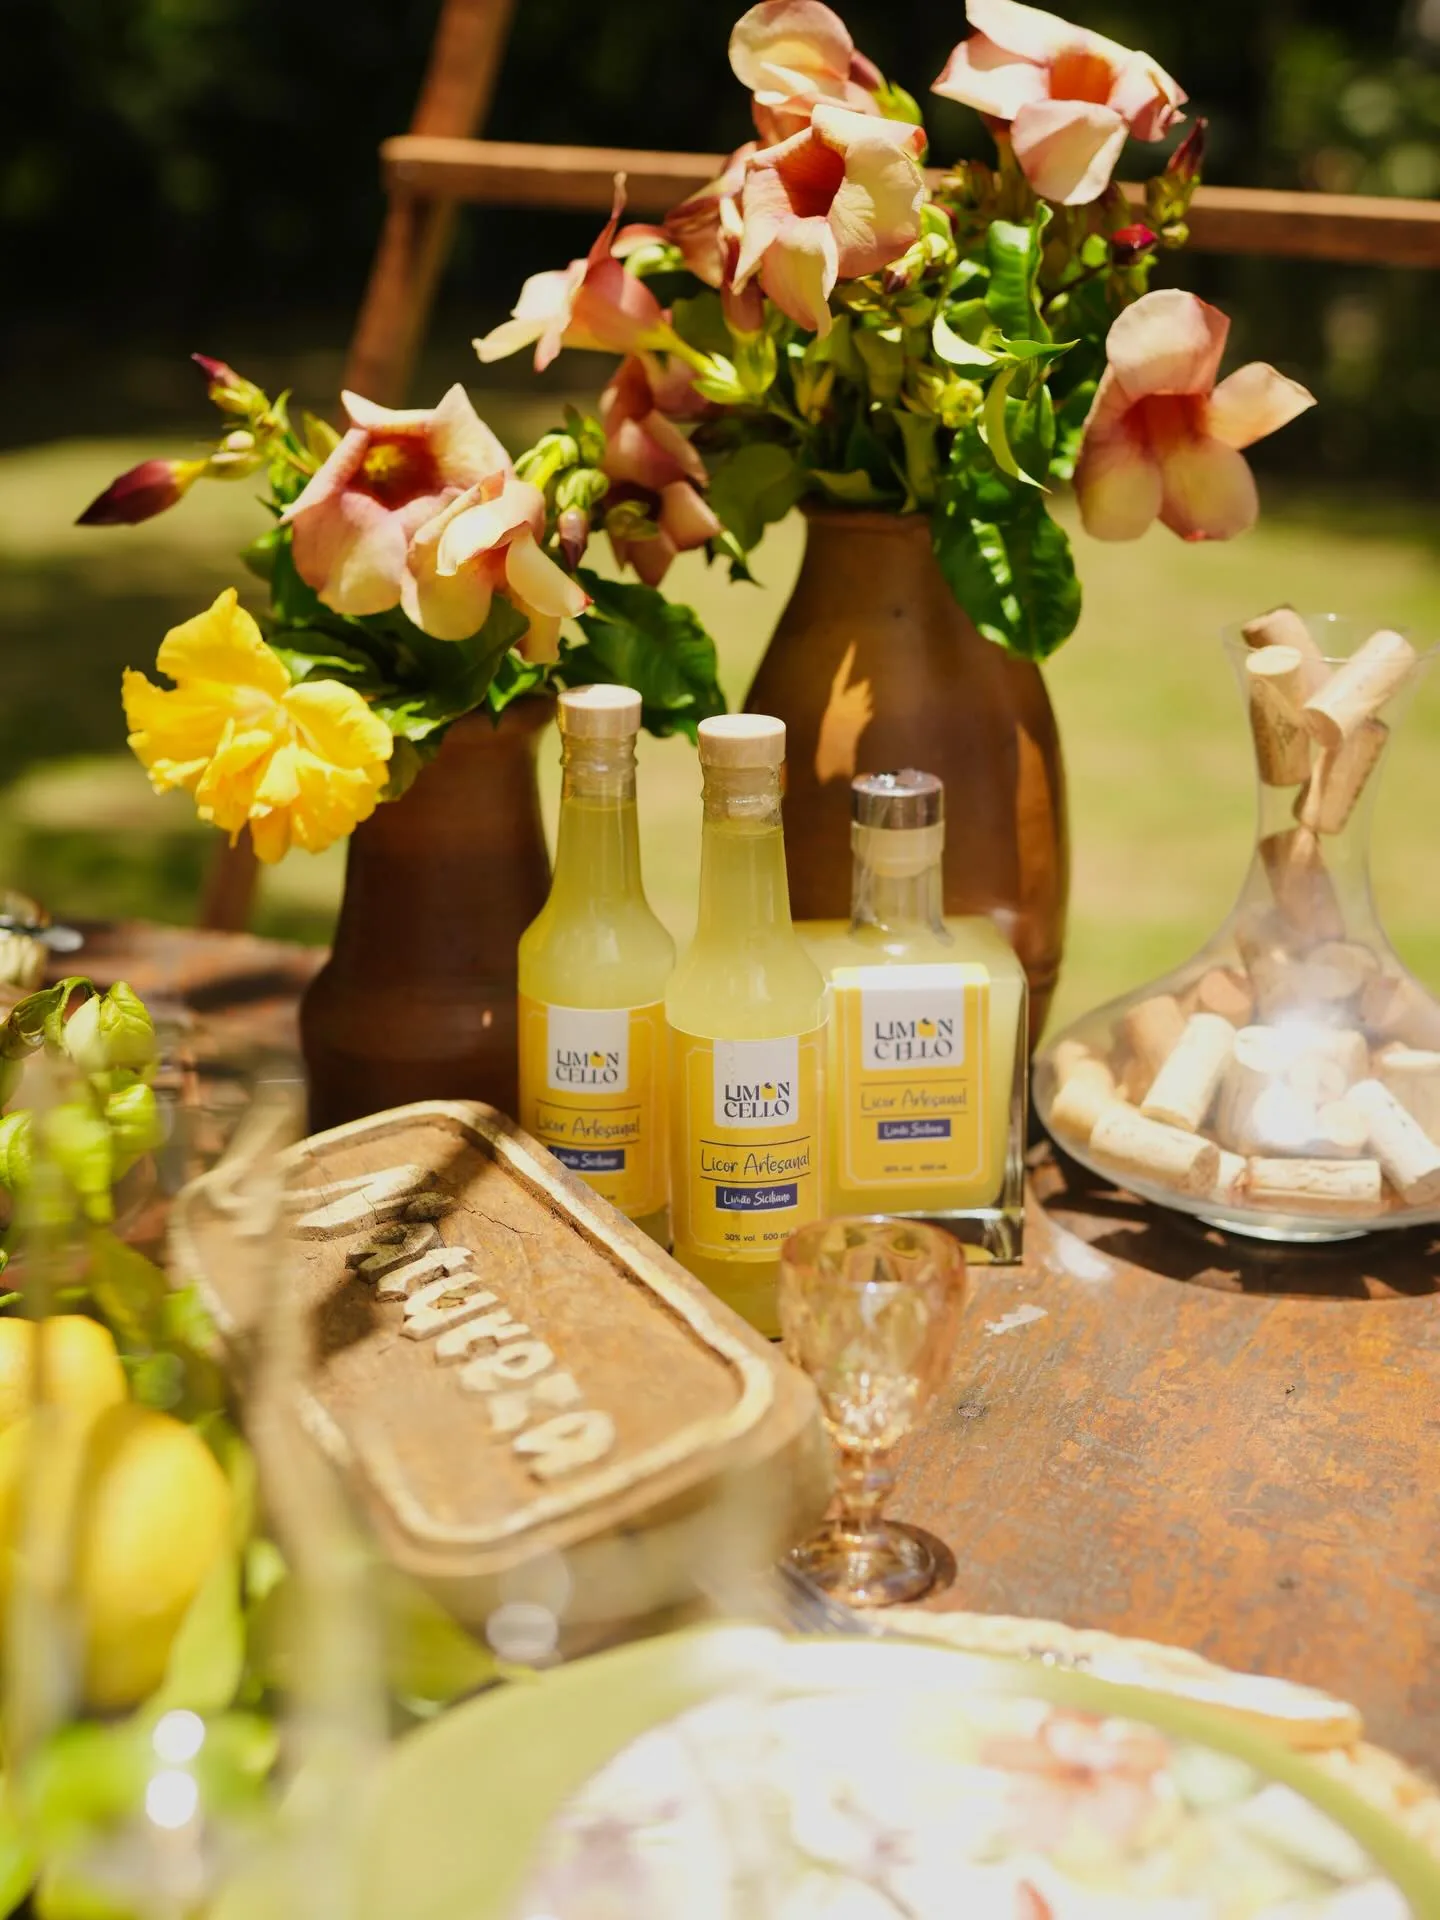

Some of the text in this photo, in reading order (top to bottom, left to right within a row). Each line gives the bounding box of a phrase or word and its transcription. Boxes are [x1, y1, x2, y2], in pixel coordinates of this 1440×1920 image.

[724, 1099, 790, 1118] CELLO
[701, 1144, 810, 1177] Licor Artesanal
[723, 1190, 752, 1205] Limão
